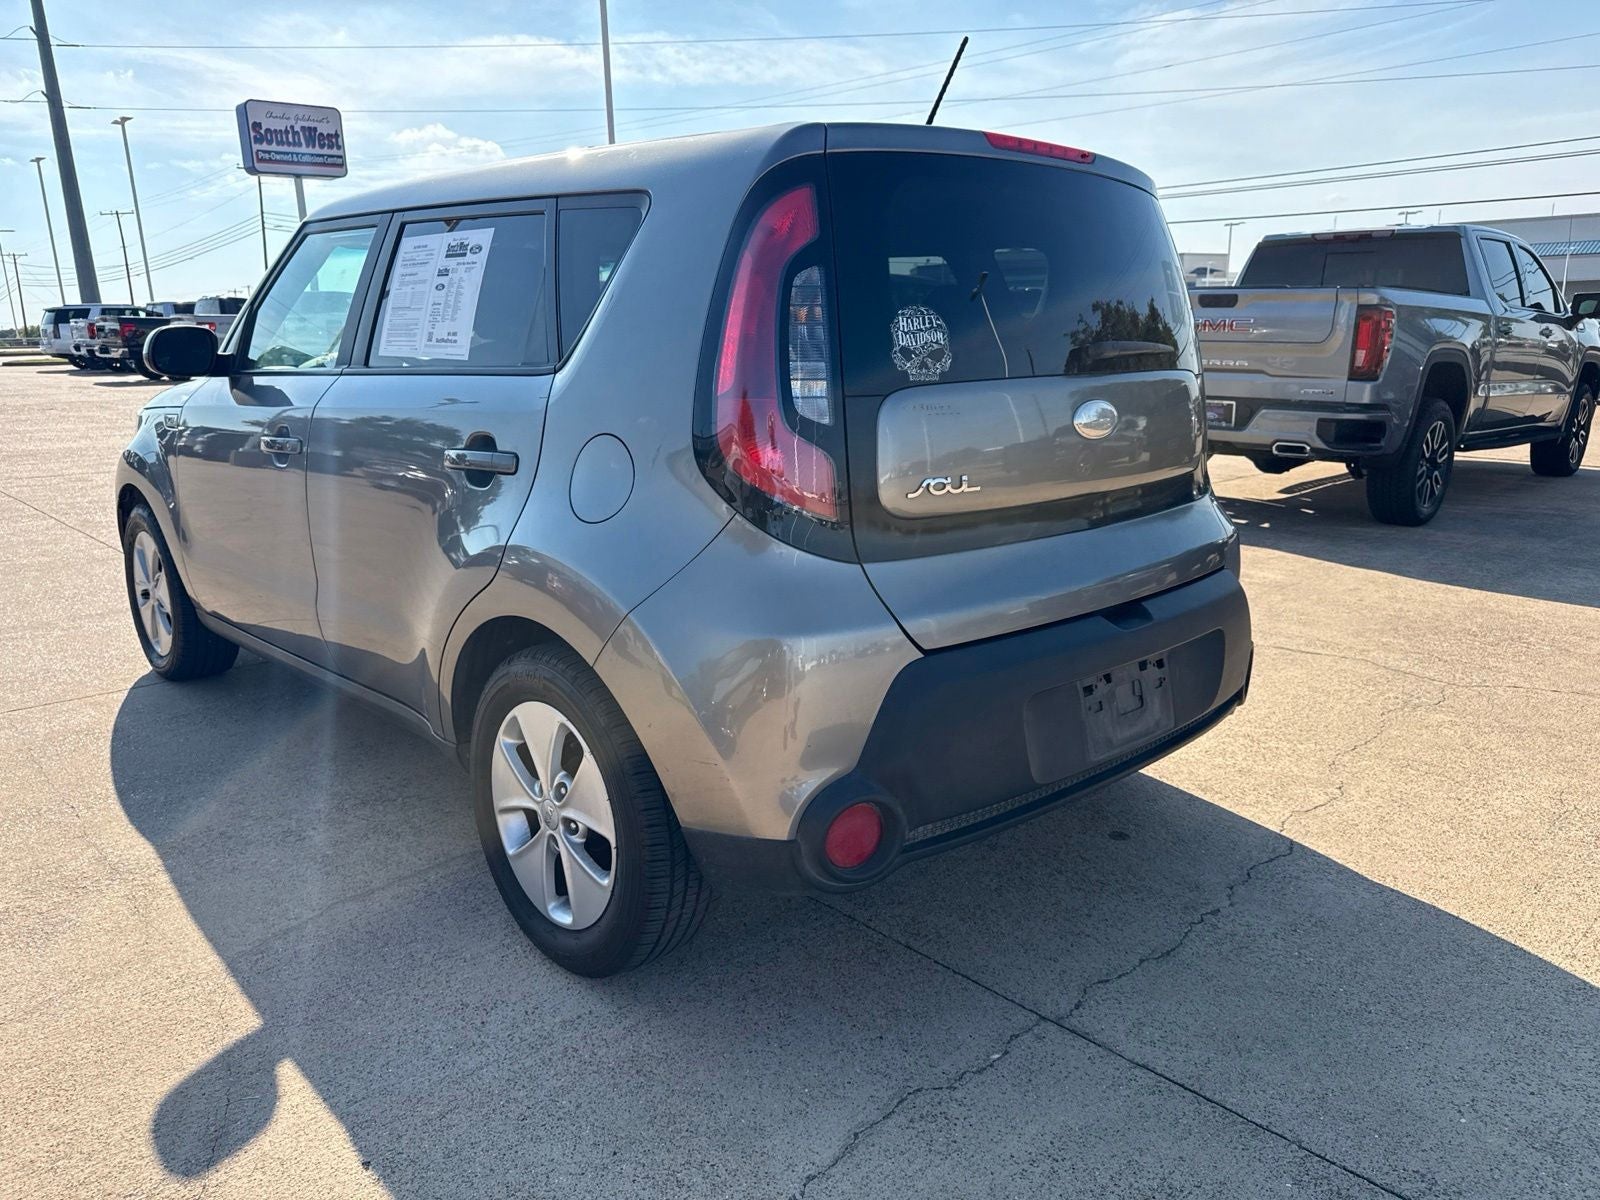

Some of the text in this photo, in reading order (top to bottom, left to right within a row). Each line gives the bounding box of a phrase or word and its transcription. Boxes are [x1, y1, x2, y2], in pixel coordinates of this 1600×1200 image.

[251, 120, 342, 151] SouthWest
[258, 151, 292, 162] Pre-Owned
[898, 330, 945, 346] DAVIDSON
